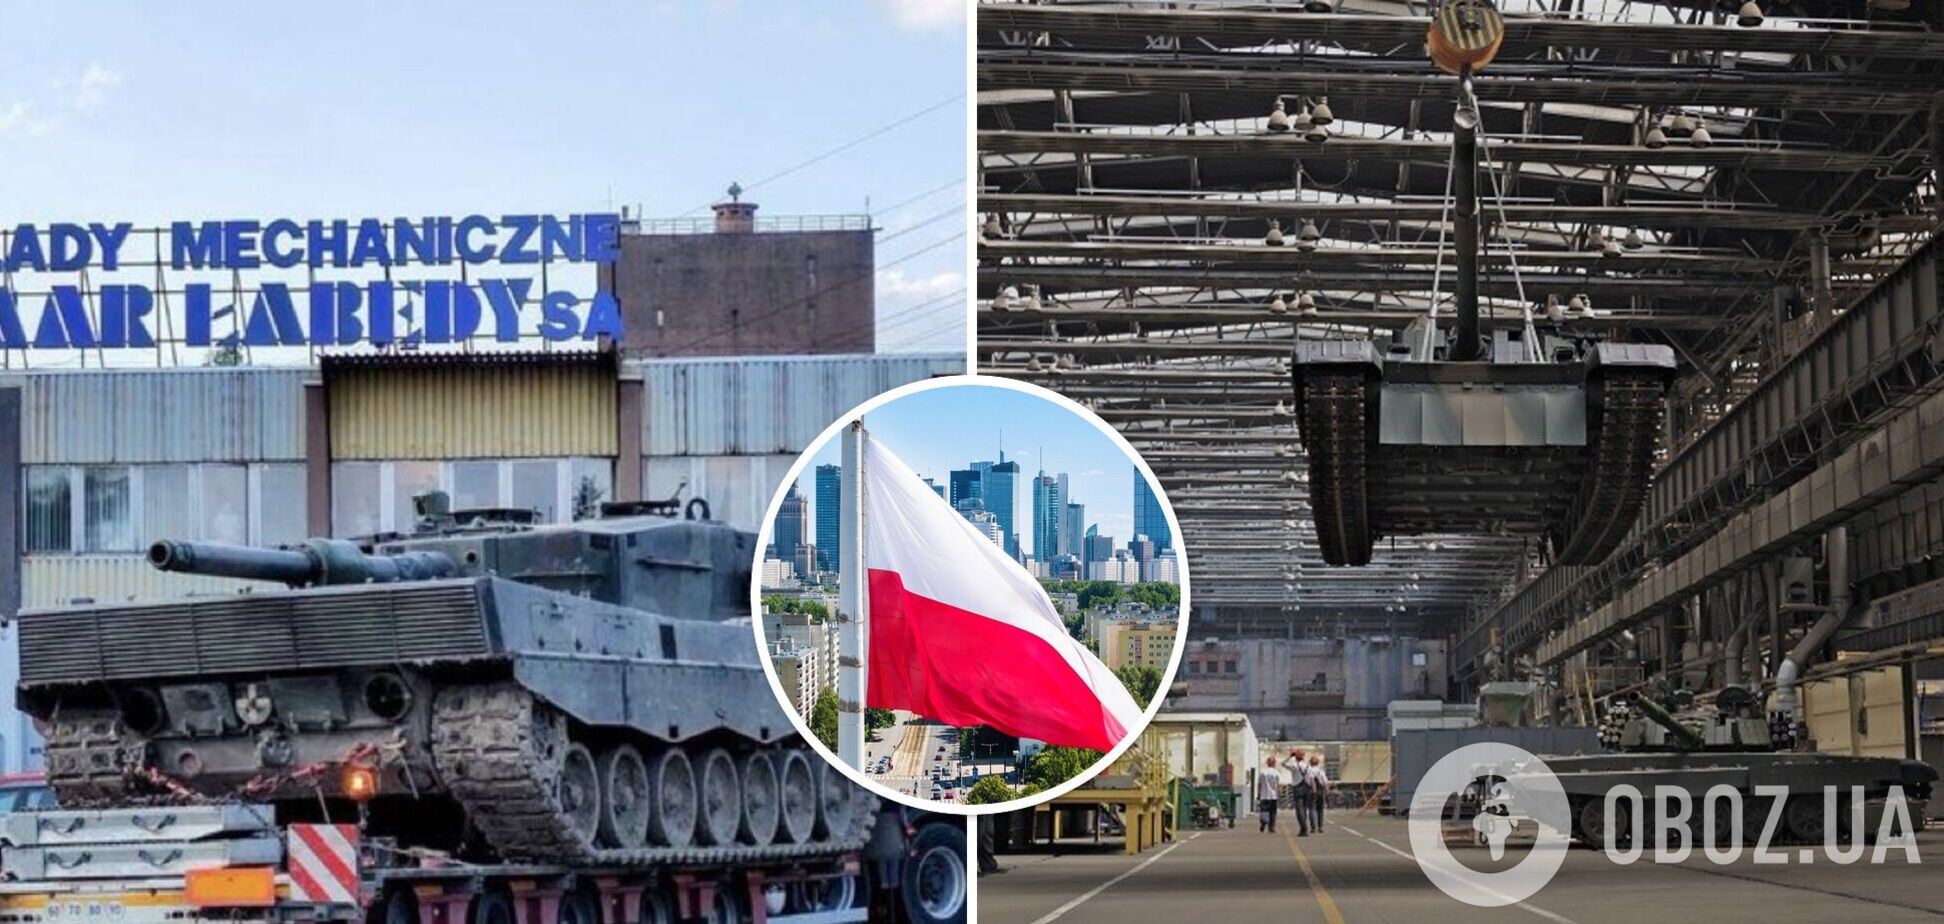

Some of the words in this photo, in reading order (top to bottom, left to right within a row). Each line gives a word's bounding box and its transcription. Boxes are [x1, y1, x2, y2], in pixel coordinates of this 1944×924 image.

[0, 222, 133, 272] ADY
[172, 213, 620, 270] MECHANICZNE
[538, 289, 624, 341] SA
